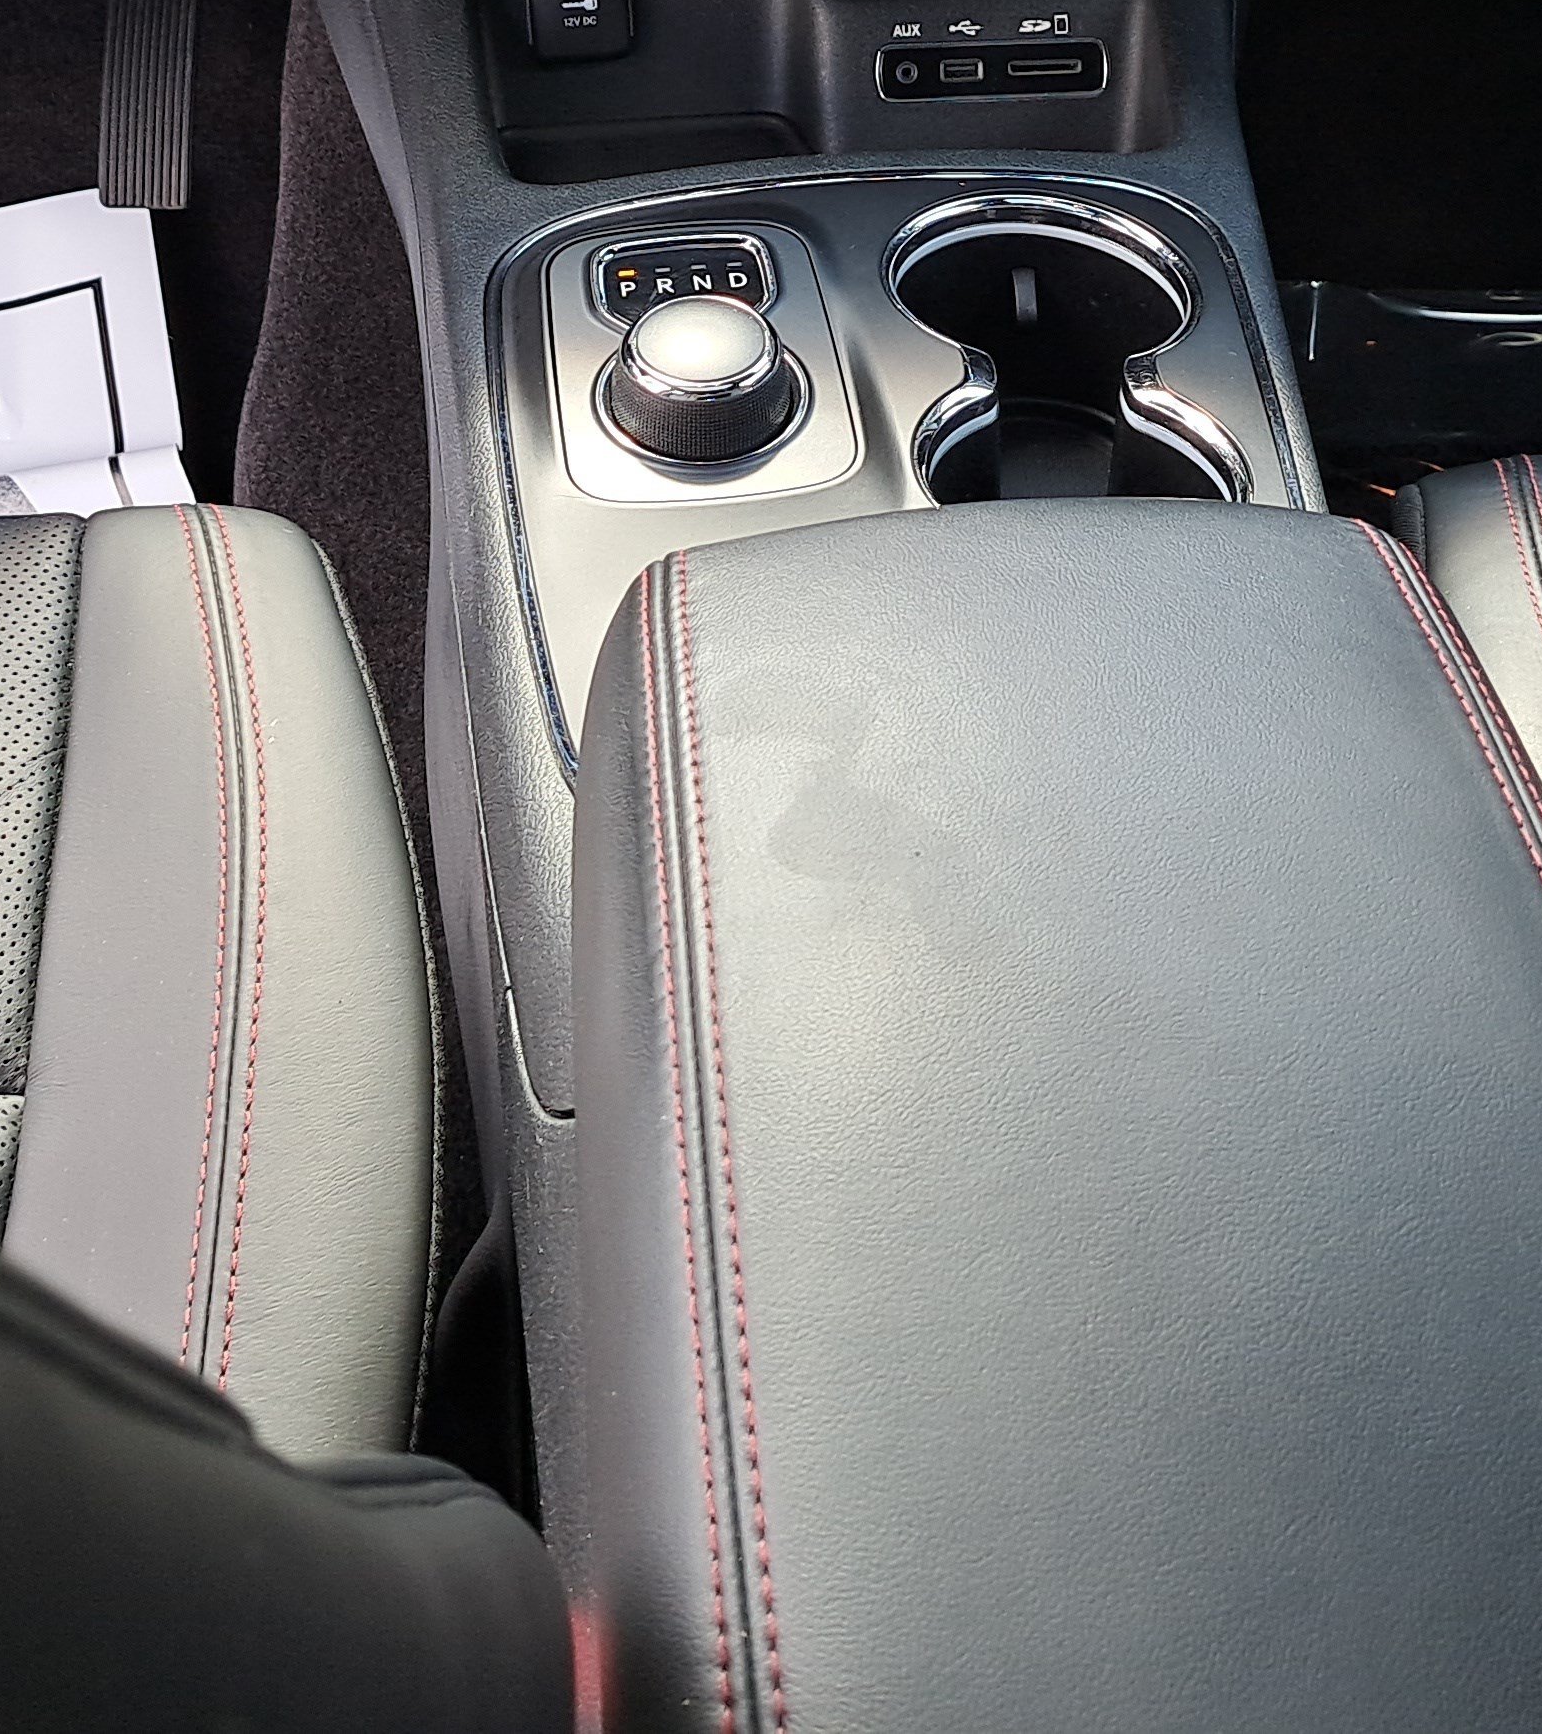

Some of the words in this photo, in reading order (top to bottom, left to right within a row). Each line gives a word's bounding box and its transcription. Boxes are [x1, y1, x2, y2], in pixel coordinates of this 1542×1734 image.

[892, 23, 921, 37] AUX
[619, 281, 636, 297] P
[655, 277, 675, 294] R
[692, 274, 712, 291] N
[728, 272, 748, 288] D
